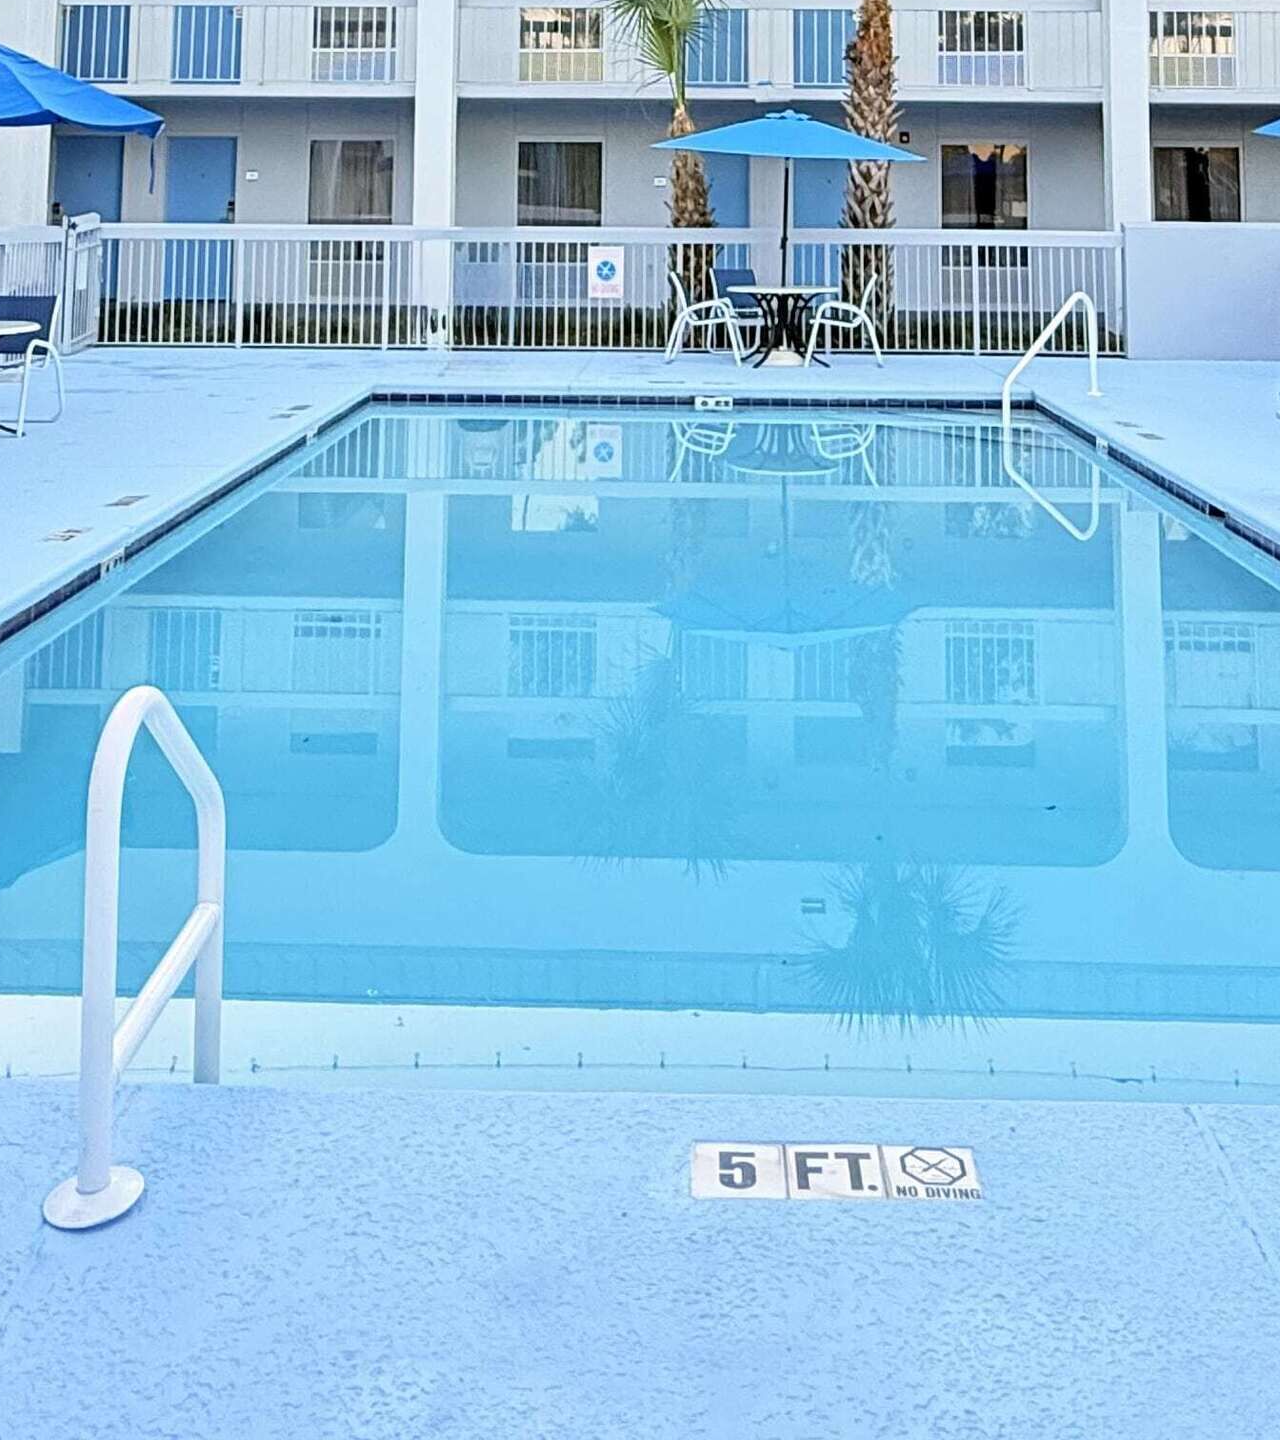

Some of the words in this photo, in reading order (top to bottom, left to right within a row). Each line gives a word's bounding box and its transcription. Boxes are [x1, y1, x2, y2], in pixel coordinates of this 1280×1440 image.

[719, 1151, 757, 1190] 5
[794, 1151, 878, 1192] FT.
[896, 1185, 919, 1198] NO
[925, 1186, 981, 1200] DIVING
